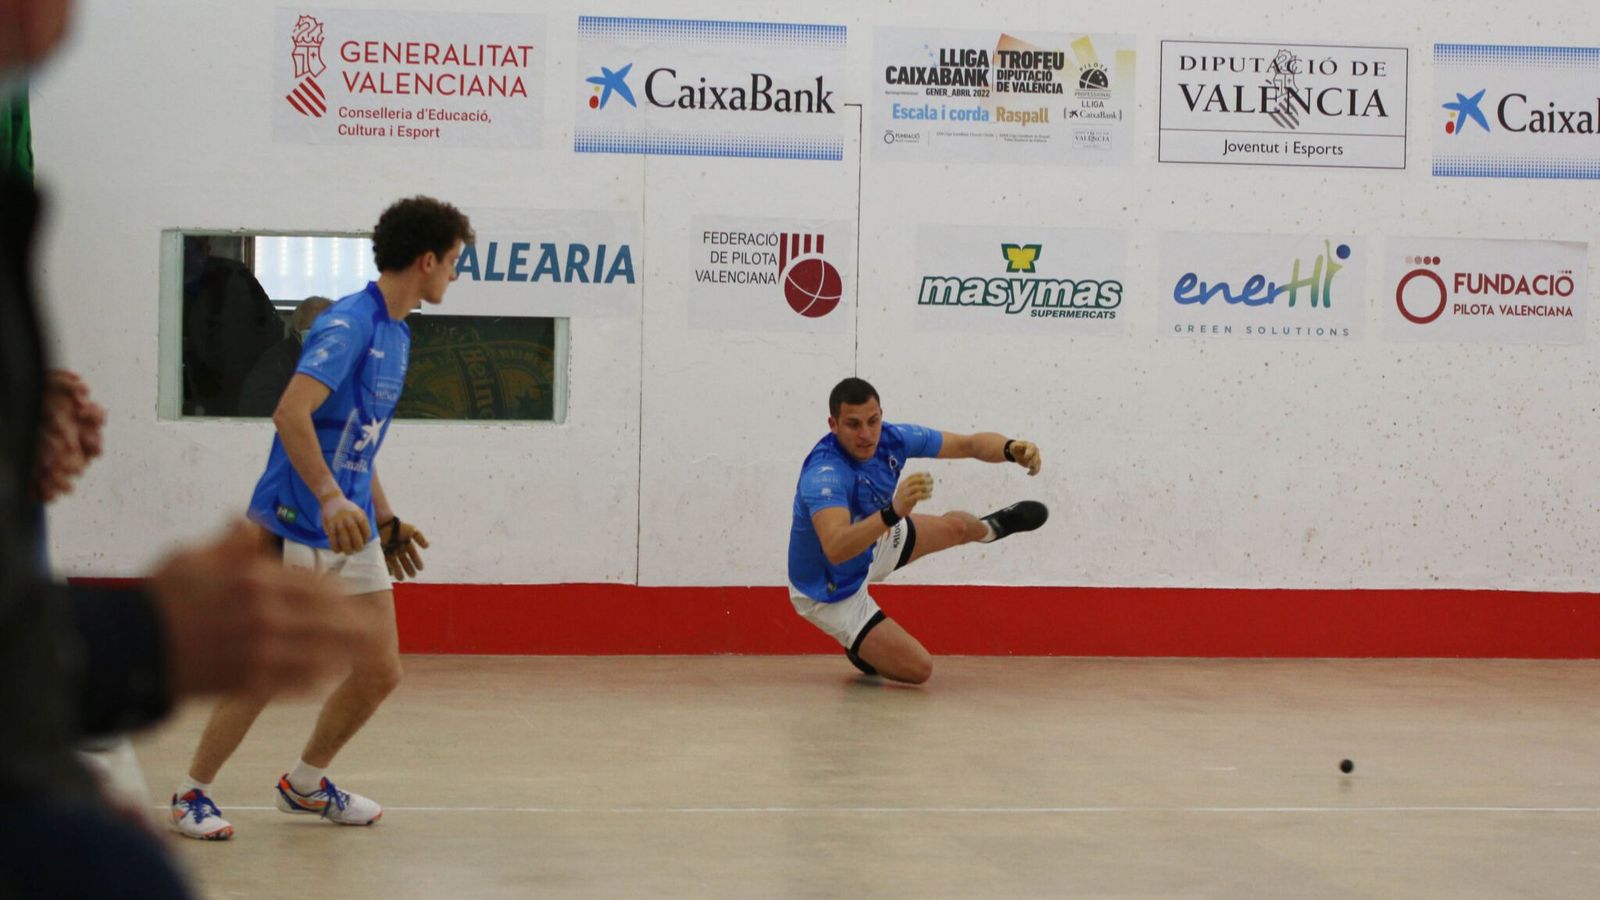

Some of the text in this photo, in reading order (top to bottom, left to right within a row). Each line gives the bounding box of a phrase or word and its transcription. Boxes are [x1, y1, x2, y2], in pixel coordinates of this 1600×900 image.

[340, 41, 534, 68] GENERALITAT
[940, 48, 990, 68] LLIGA
[997, 51, 1065, 71] TROFEU
[1179, 55, 1388, 77] DIPUTACIÓ DE
[342, 71, 528, 98] VALENCIANA
[885, 66, 989, 87] CAIXABANK
[644, 68, 836, 114] CaixaBank
[973, 89, 990, 97] 2022
[996, 82, 1010, 93] DE
[1081, 100, 1105, 108] LLIGA
[1178, 79, 1389, 118] VALÈNCIA
[338, 106, 413, 120] Conselleria
[892, 103, 938, 120] Escala
[941, 104, 946, 120] i
[1080, 109, 1118, 120] CaixaBank
[337, 124, 441, 140] Cultura i Esport
[1222, 139, 1345, 157] Joventut i Esports
[702, 230, 779, 248] FEDERACIÓ
[710, 250, 778, 266] DE PILOTA
[695, 269, 777, 285] VALENCIANA
[917, 275, 1124, 314] masymas
[1030, 308, 1117, 320] SUPERMERCATS
[1453, 303, 1574, 318] PILOTA VALENCIANA
[1173, 323, 1351, 337] GREEN SOLUTIONS
